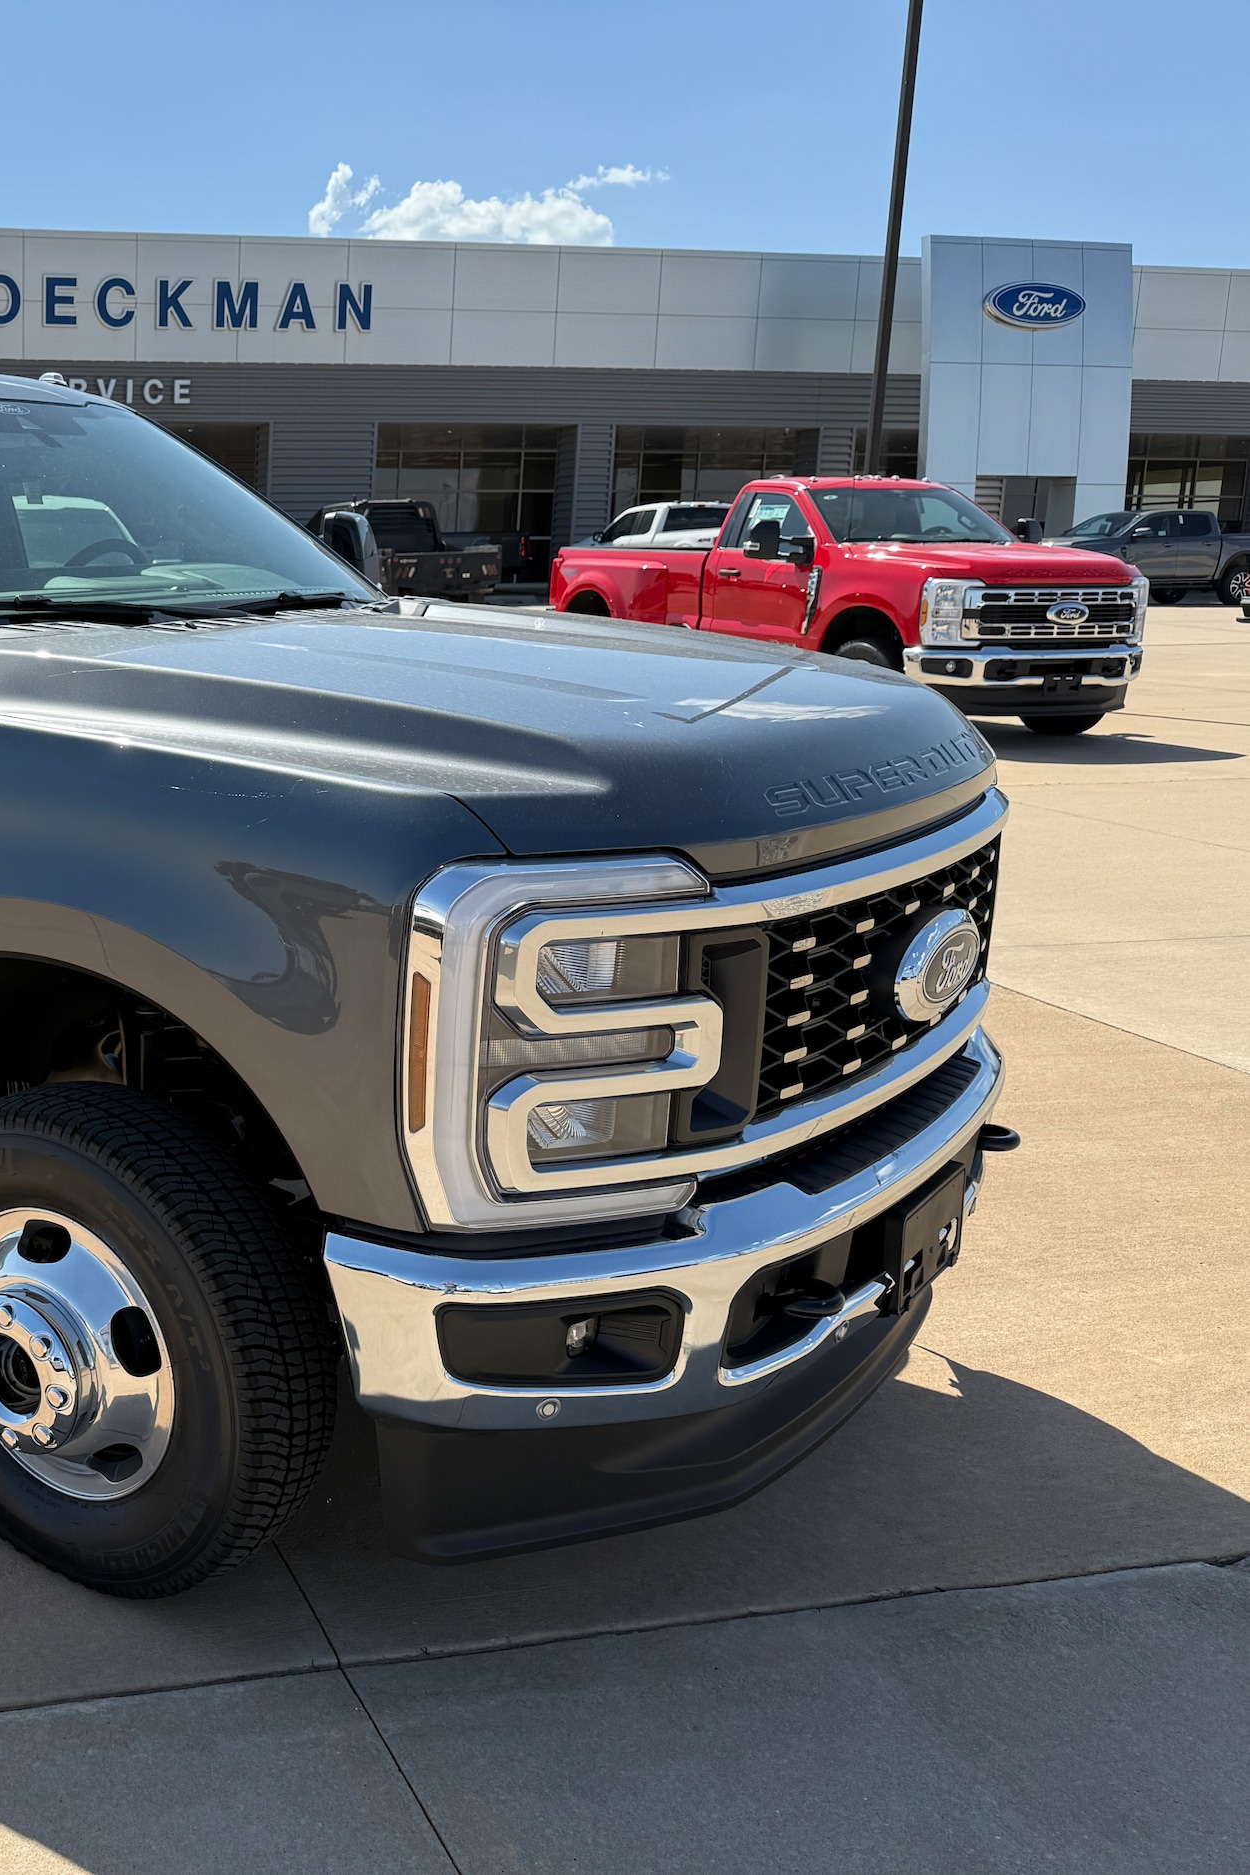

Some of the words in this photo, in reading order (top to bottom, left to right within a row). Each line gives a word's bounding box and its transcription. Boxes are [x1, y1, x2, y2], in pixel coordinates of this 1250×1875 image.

[1012, 290, 1067, 318] Ford
[1060, 608, 1081, 619] Ford
[763, 755, 928, 817] SUPER
[916, 731, 976, 777] DUTY
[935, 941, 972, 994] Ford
